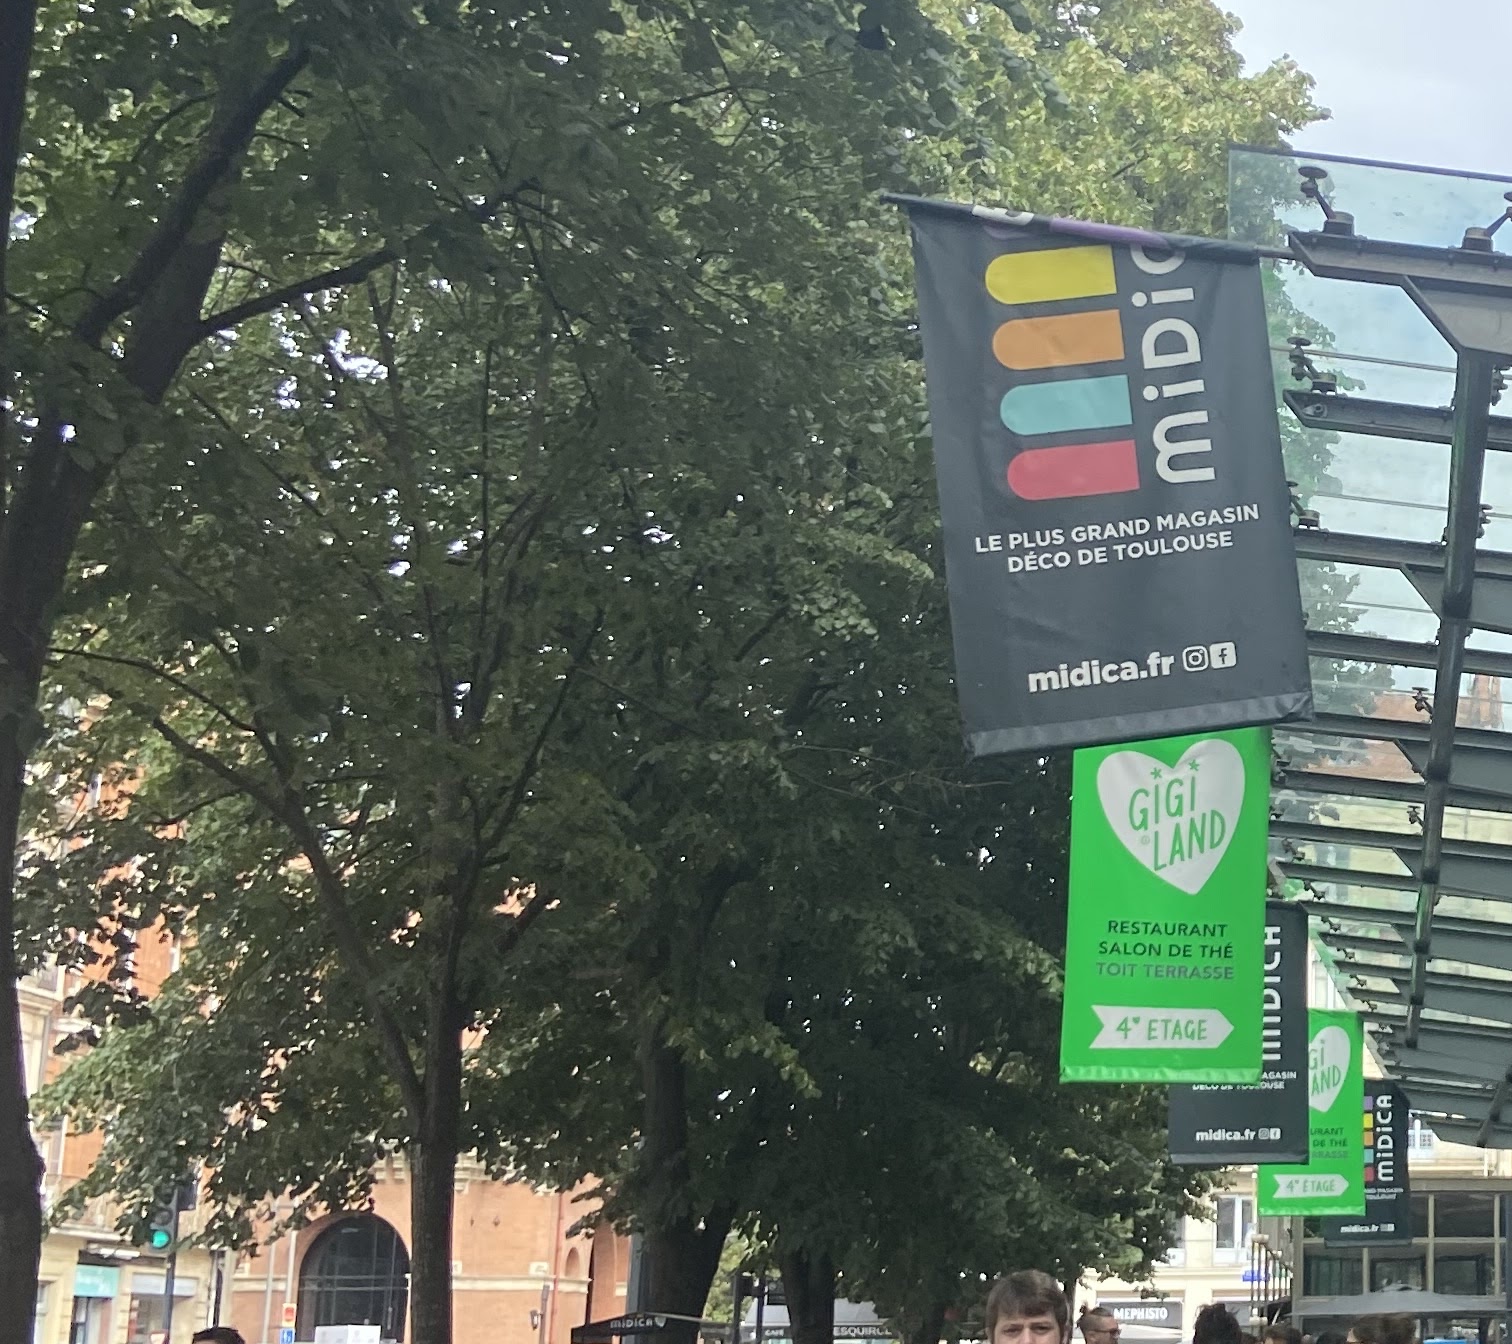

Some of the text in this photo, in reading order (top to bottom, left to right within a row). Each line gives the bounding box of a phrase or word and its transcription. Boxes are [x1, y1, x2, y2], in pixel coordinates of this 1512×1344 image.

[975, 503, 1260, 553] LE PLUS GRAND MAGASIN
[1008, 530, 1234, 573] DÉCO DE TOULOUSE
[1028, 650, 1175, 693] midica.fr
[1129, 775, 1196, 831] GIGI
[1153, 809, 1226, 871] LAND
[1107, 920, 1228, 937] RESTAURANT
[1098, 941, 1234, 959] SALON DE THÉ
[1096, 962, 1234, 980] TOIT TERRASSE
[1311, 1064, 1342, 1096] AND
[1195, 1128, 1256, 1142] midica.fr
[1113, 1307, 1168, 1320] MEPHISTO
